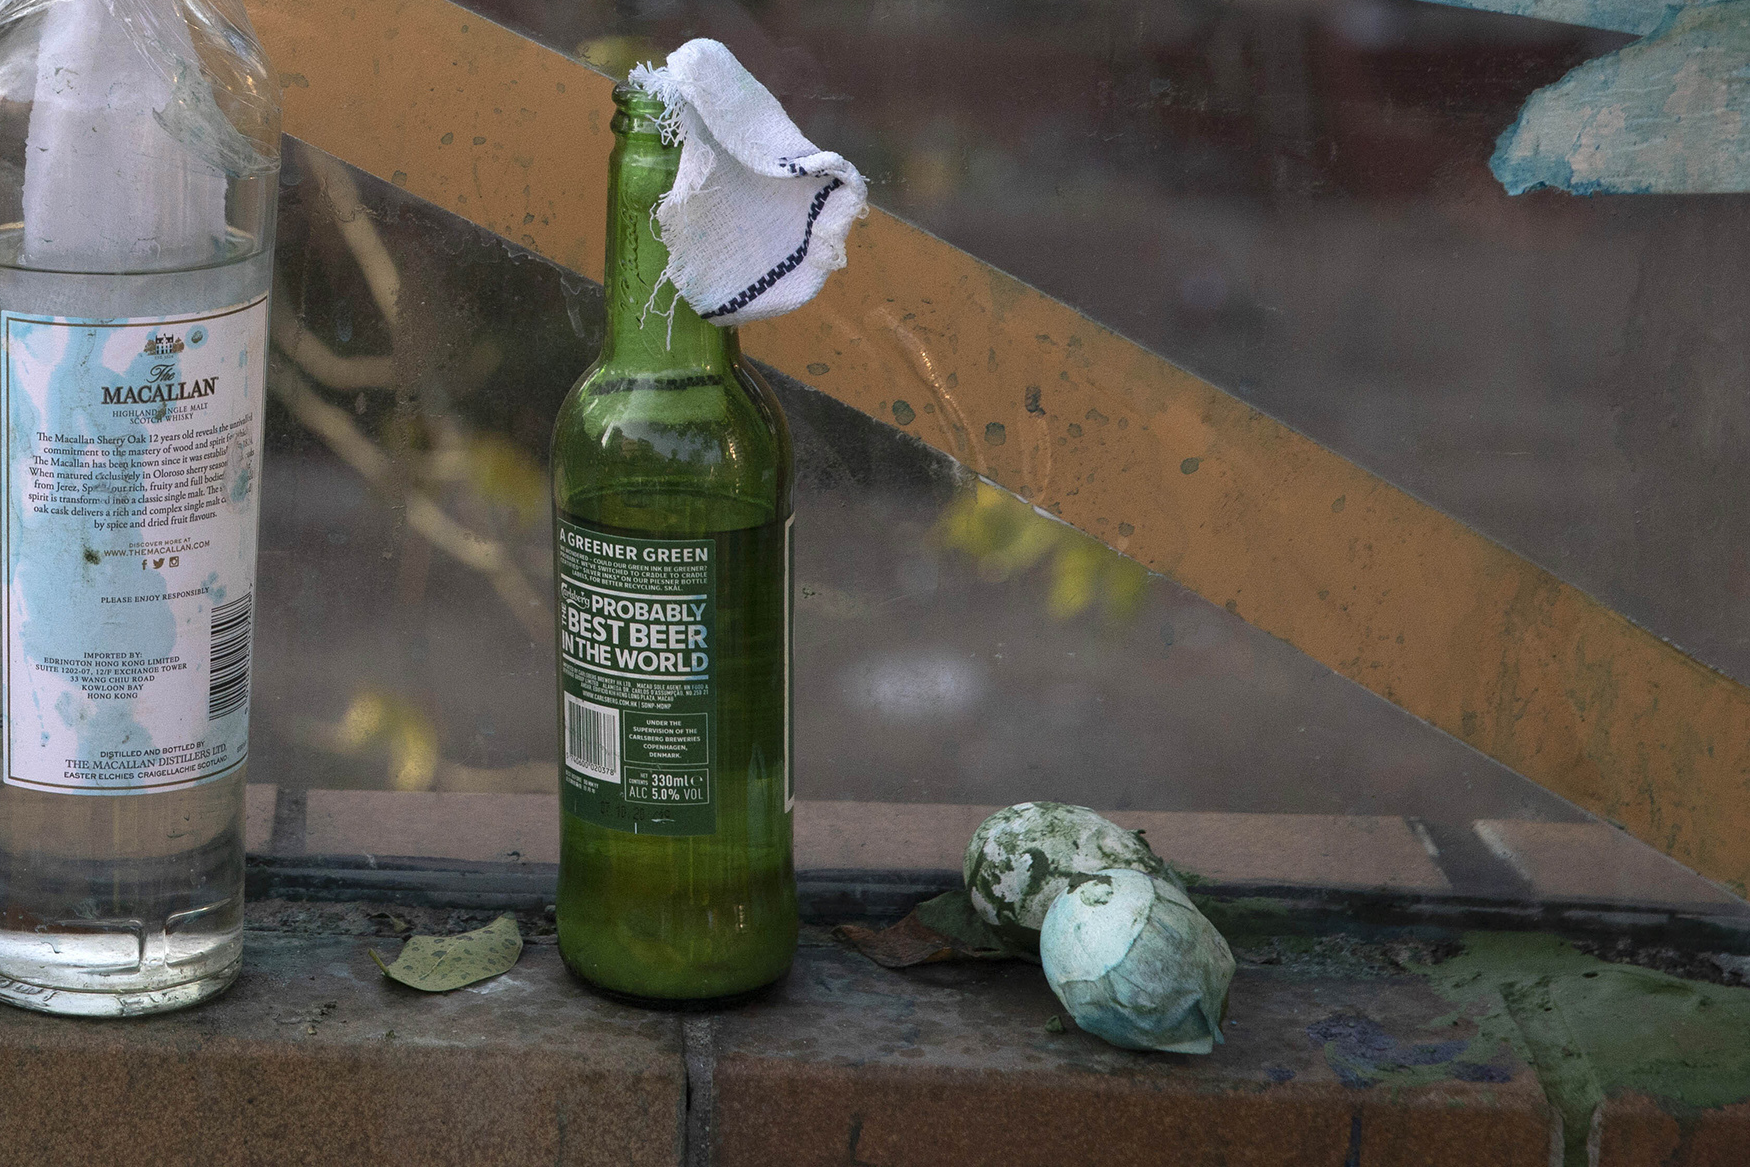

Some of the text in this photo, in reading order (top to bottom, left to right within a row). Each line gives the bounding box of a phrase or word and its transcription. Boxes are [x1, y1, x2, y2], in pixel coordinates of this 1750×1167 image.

[146, 363, 175, 383] The
[101, 376, 216, 405] MACALLAN
[112, 403, 208, 418] HIGHLAND INGLE MALT
[130, 412, 194, 424] SCOTCH WHISKY
[36, 432, 52, 442] The
[54, 434, 95, 444] Macallan
[97, 435, 125, 448] Sherry
[127, 434, 146, 444] Oak
[149, 434, 159, 443] 12
[160, 433, 181, 444] years
[182, 429, 194, 439] old
[195, 425, 218, 438] reveals
[219, 422, 229, 433] the
[43, 447, 99, 456] commitment
[112, 447, 126, 457] the
[128, 446, 161, 457] mastery
[162, 443, 172, 454] of
[173, 442, 193, 452] wood
[195, 439, 208, 449] and
[210, 435, 228, 448] spirit
[34, 504, 49, 514] oak
[50, 506, 69, 515] cask
[71, 506, 103, 517] delivers
[112, 507, 129, 516] rich
[131, 505, 147, 516] and
[149, 503, 182, 515] complex
[184, 500, 205, 512] single
[205, 496, 220, 507] malt
[94, 511, 217, 531] by spice and dried fruit flavours.
[103, 540, 210, 556] WWW.THEMACALLAN.COM
[559, 527, 708, 563] A GREENER GREEN
[593, 558, 612, 567] COULD
[601, 579, 623, 587] BETTER
[101, 586, 210, 604] PLEASE ENJOY RESPONSIBLY
[561, 582, 706, 622] Carlsberg PROBABLY
[567, 607, 625, 645] BEST
[629, 622, 708, 649] BEER
[562, 629, 575, 655] IN
[575, 637, 611, 667] THE
[615, 647, 709, 673] WORLD
[35, 664, 59, 673] SUITE
[114, 666, 159, 675] EXCHANGE
[161, 662, 188, 672] TOWER
[43, 657, 93, 667] EDRINGTON
[147, 656, 180, 665] LIMITED
[132, 675, 155, 683] ROAD
[628, 734, 664, 742] CARLSBERG
[633, 726, 674, 734] SUPERVISION
[143, 748, 160, 756] AND
[162, 743, 195, 755] BOTTLED
[196, 740, 205, 749] BY
[643, 743, 688, 751] COPENHAGEN,
[65, 759, 90, 770] THE
[92, 758, 156, 770] MACALLAN
[158, 750, 211, 767] DISTILLERS
[212, 743, 228, 756] LTD.
[64, 754, 228, 780] EASTER ELCHIES CRAIGELLACHIE SCOTLAND
[651, 774, 689, 787] 330ml
[629, 786, 703, 801] ALC 5.0% VOL
